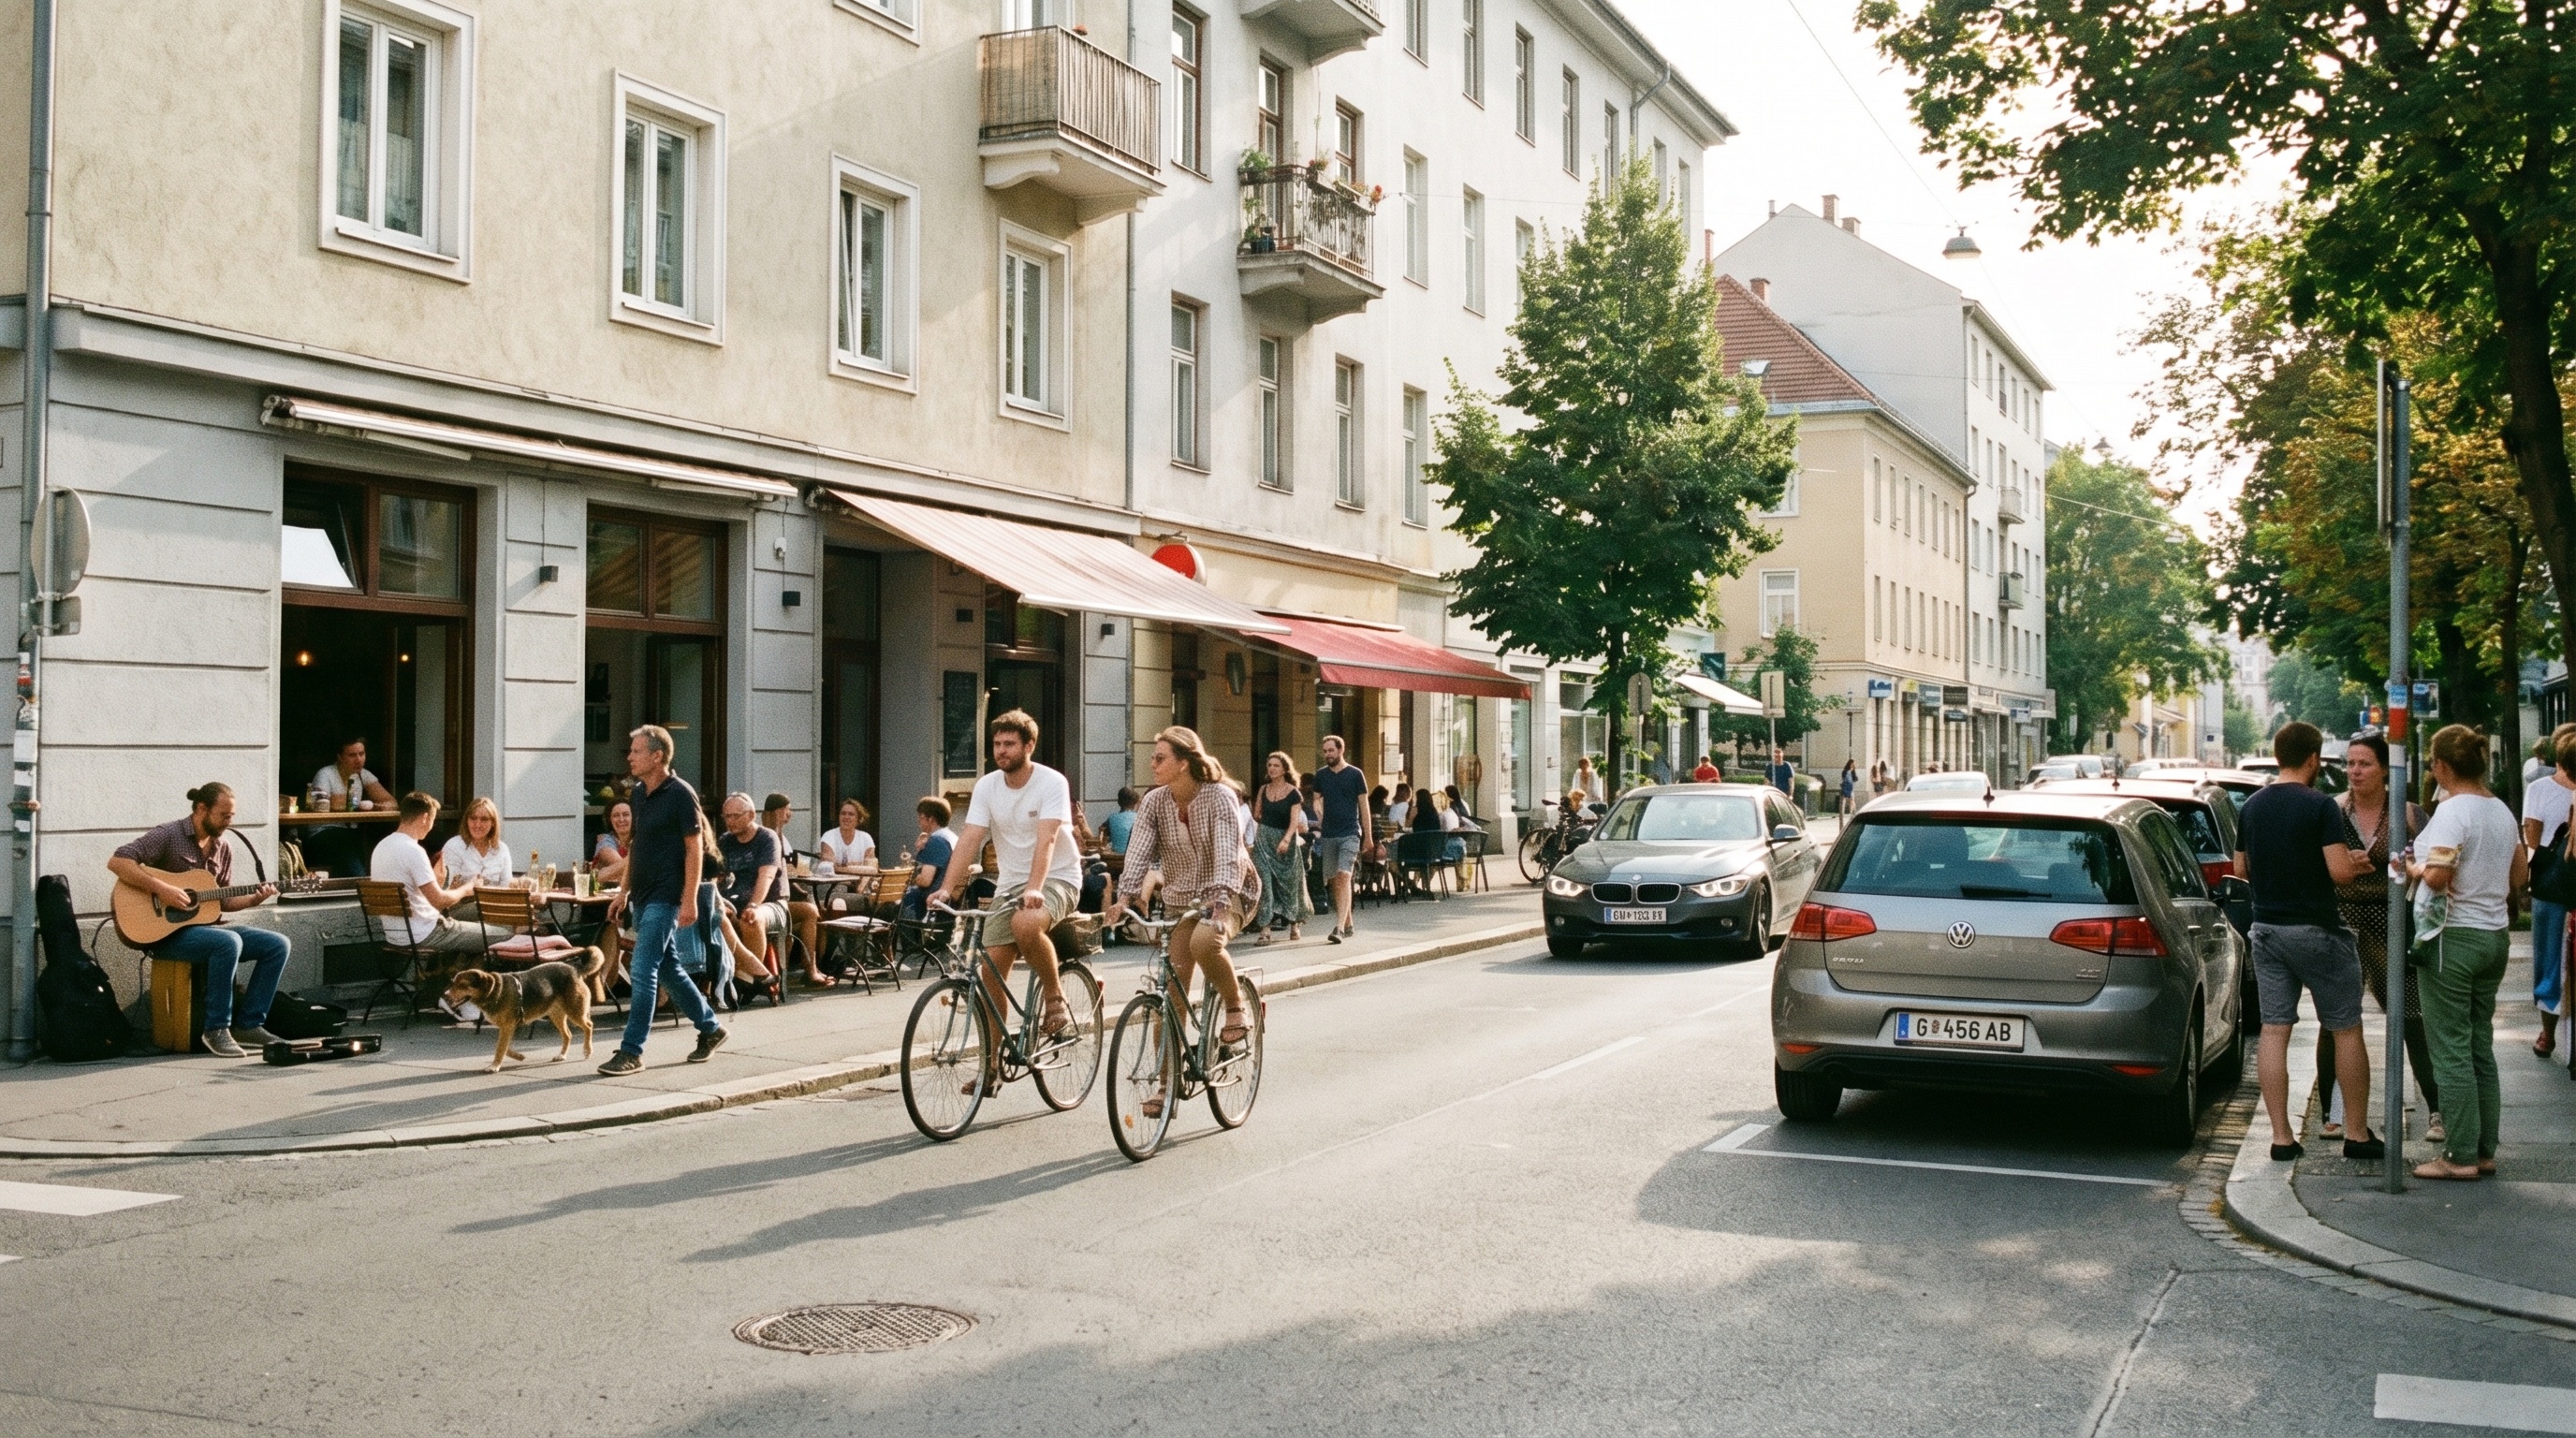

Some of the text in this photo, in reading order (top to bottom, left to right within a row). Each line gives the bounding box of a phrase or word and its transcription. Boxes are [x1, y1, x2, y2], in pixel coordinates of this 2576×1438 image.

[1916, 1018, 2012, 1042] G 456 AB
